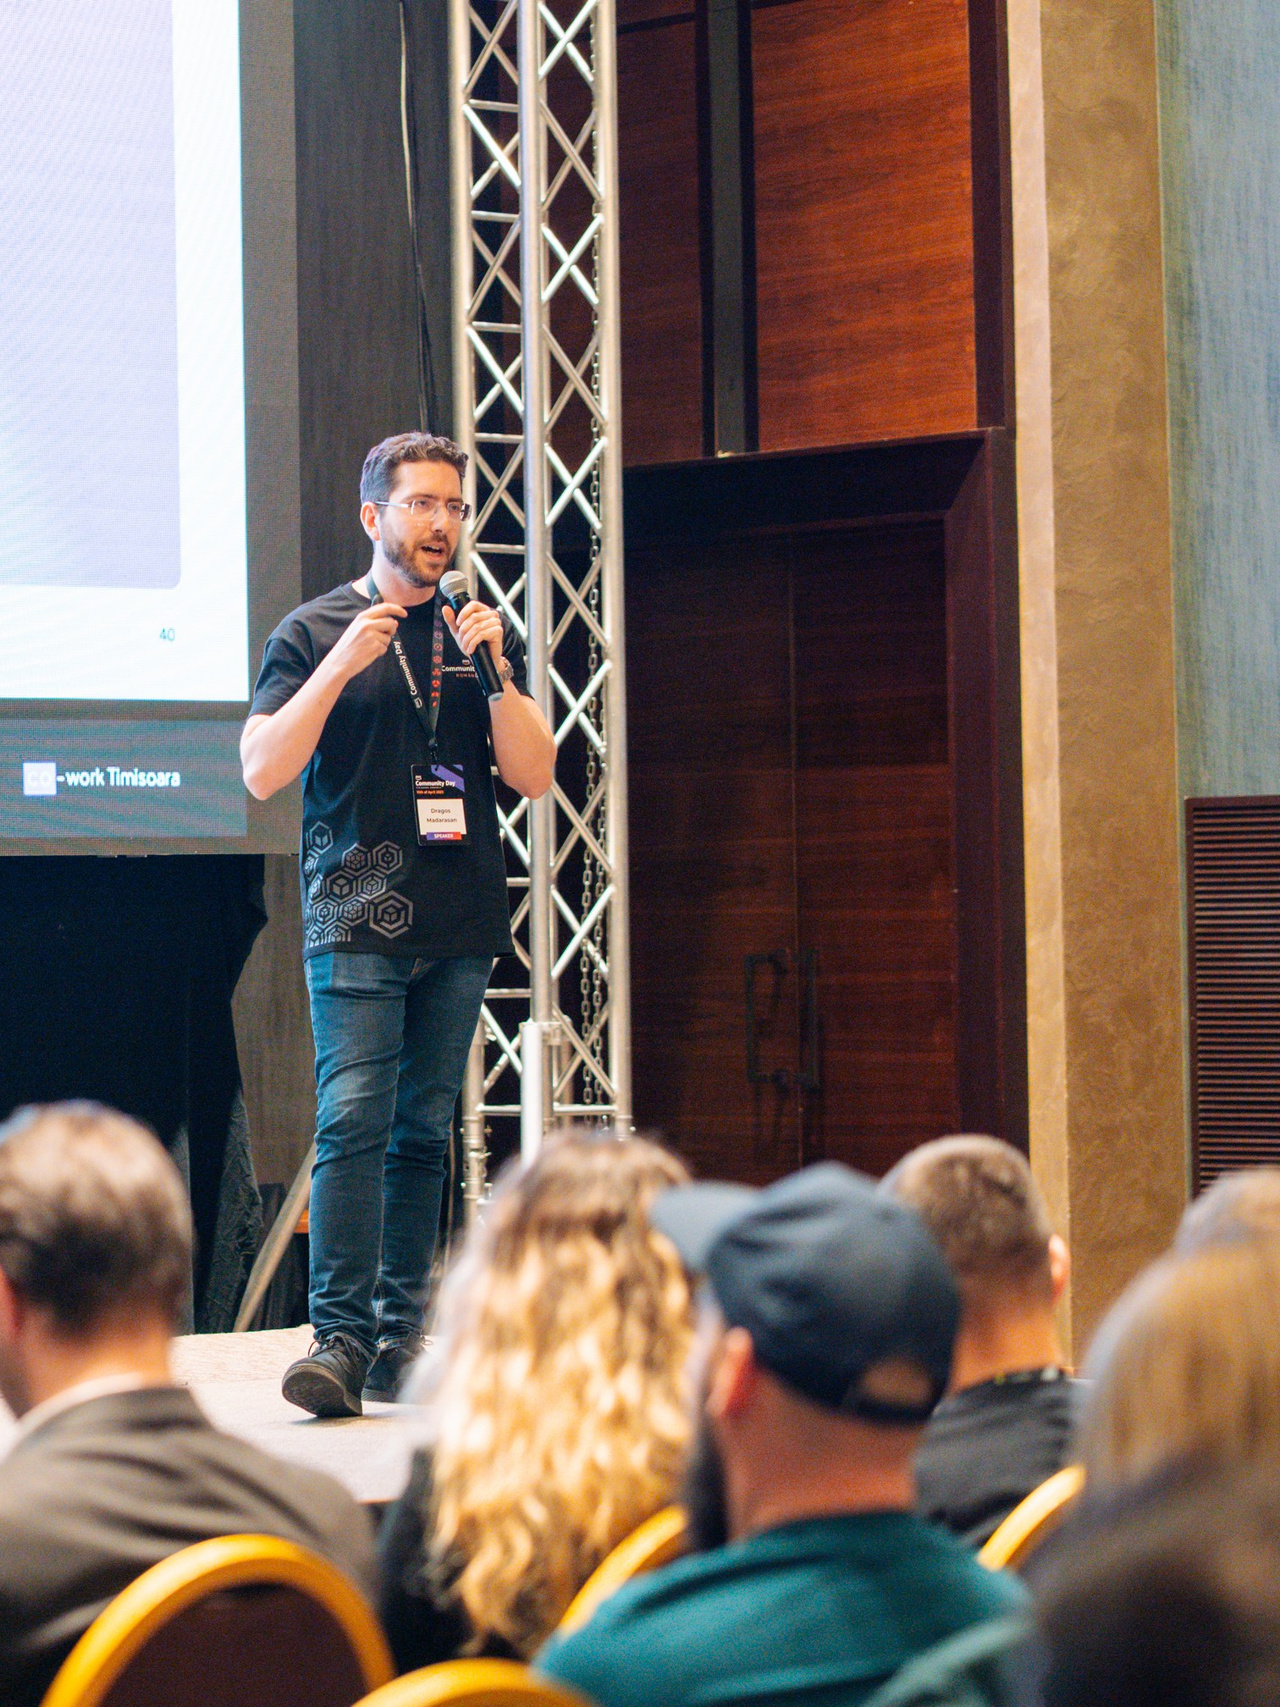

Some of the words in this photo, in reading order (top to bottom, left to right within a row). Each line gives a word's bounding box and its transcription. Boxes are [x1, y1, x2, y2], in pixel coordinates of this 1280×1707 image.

[159, 627, 176, 642] 40
[393, 641, 403, 655] Day
[399, 655, 418, 696] Community
[106, 766, 181, 788] Timisoara
[415, 780, 445, 788] Community
[445, 780, 456, 788] Day
